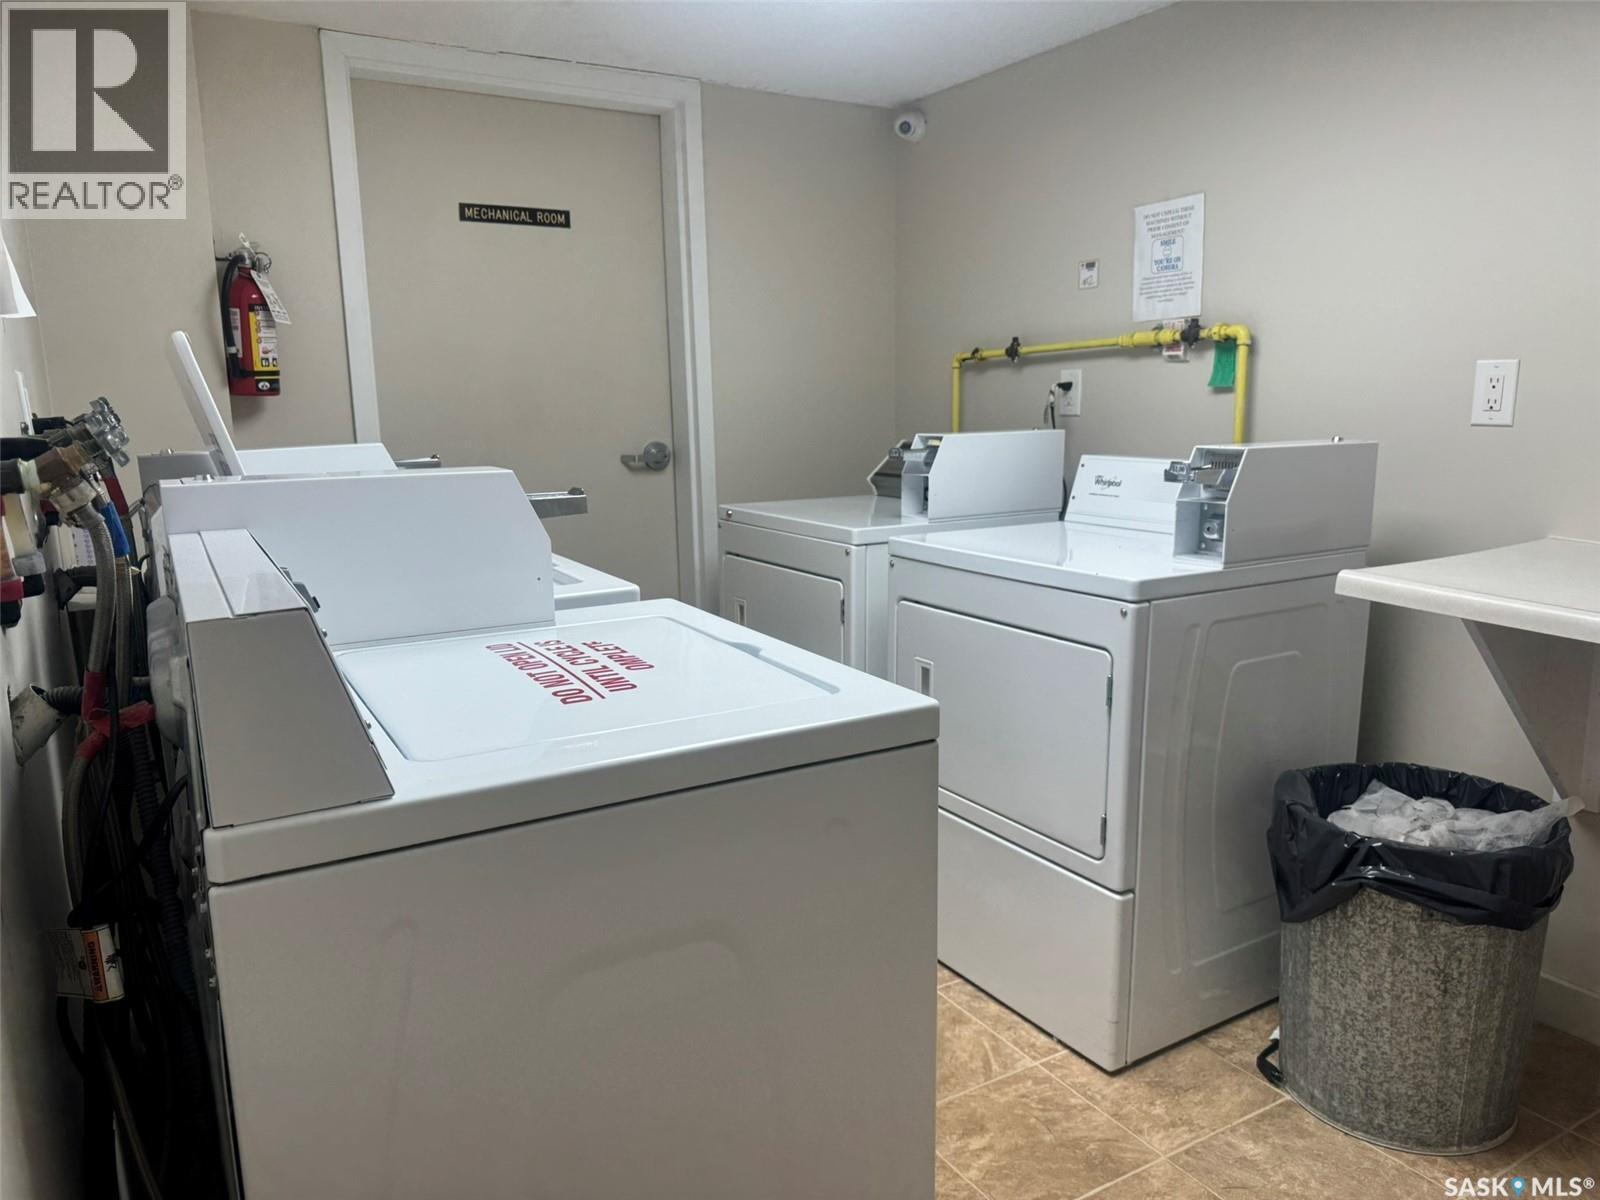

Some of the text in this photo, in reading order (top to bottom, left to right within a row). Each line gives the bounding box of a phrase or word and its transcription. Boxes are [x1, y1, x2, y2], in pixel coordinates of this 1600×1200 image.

[465, 207, 566, 224] MECHANICAL ROOM
[499, 651, 549, 671] OPEN
[544, 644, 600, 666] CYCLE
[526, 669, 575, 689] NOT
[581, 664, 638, 692] UNTIL
[551, 687, 593, 705] DO
